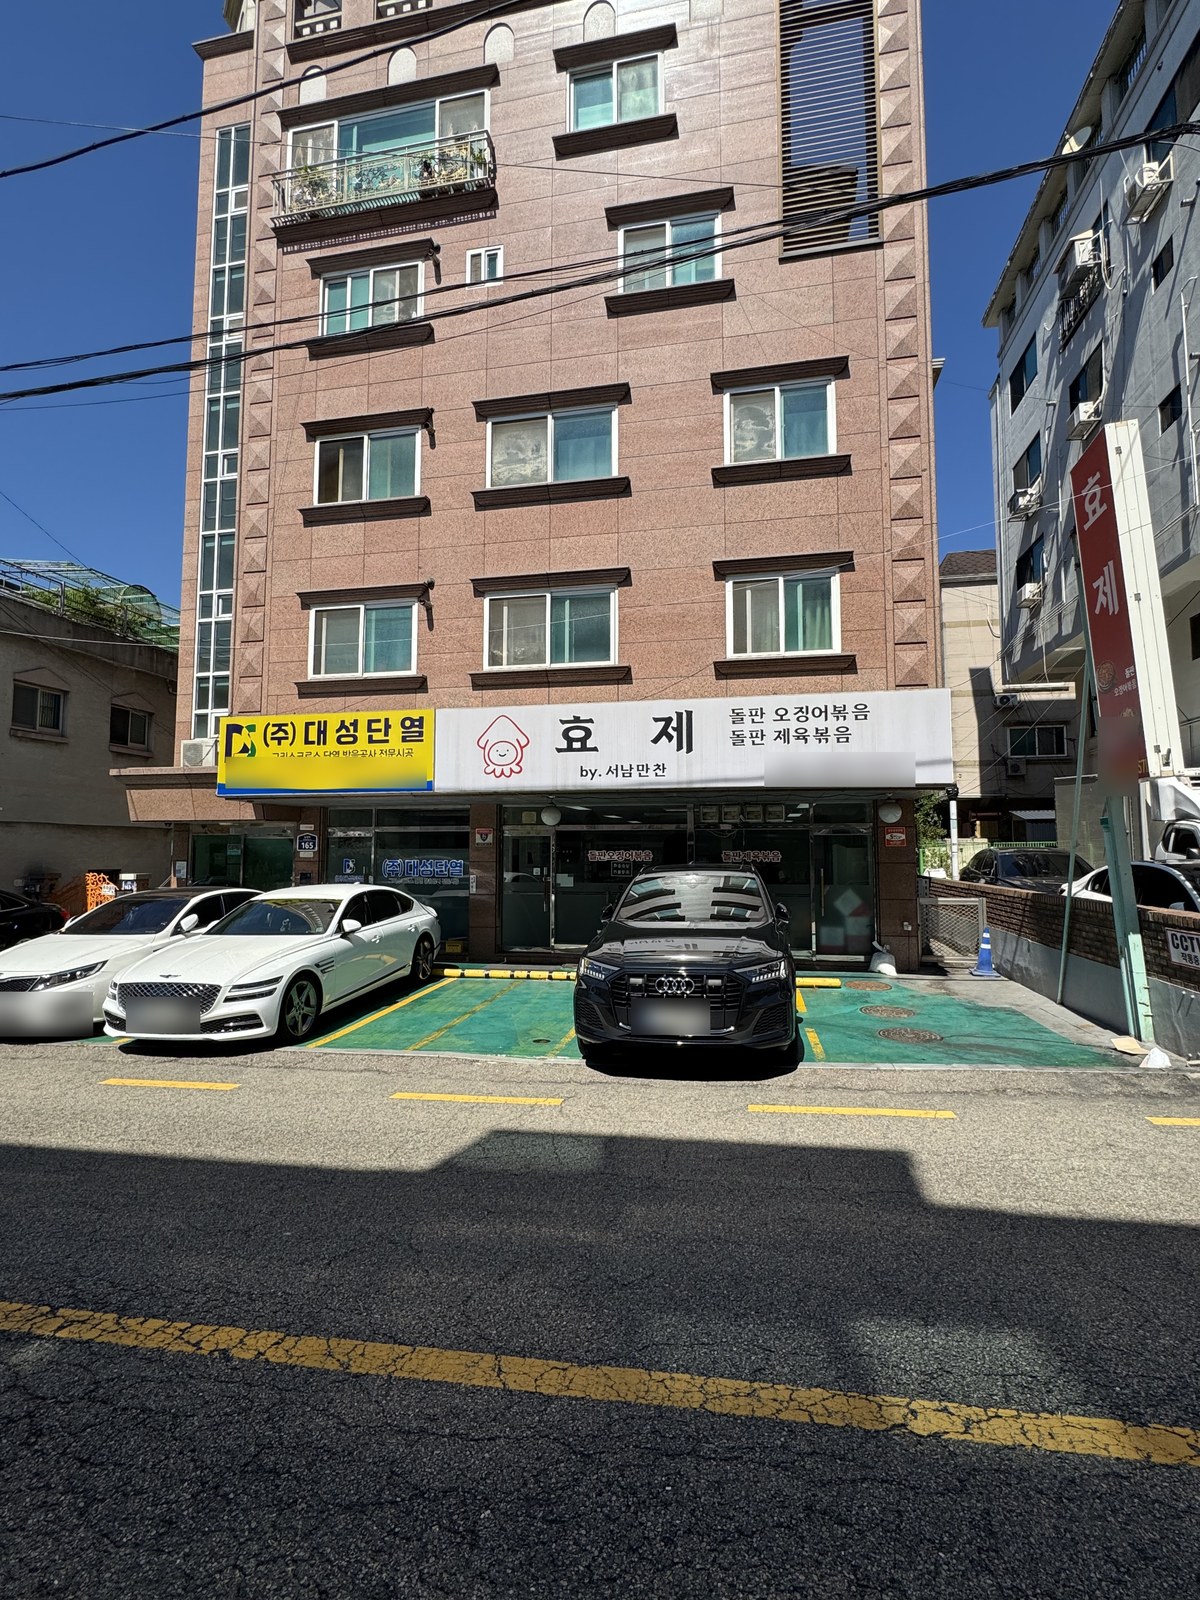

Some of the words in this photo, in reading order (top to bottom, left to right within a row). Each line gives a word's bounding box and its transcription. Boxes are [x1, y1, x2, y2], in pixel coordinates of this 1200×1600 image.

[729, 706, 766, 725] 돌판
[772, 703, 871, 723] 오징어볶음
[729, 728, 766, 747] 돌판
[773, 725, 852, 745] 제육볶음
[381, 858, 464, 878] (주)대성단열
